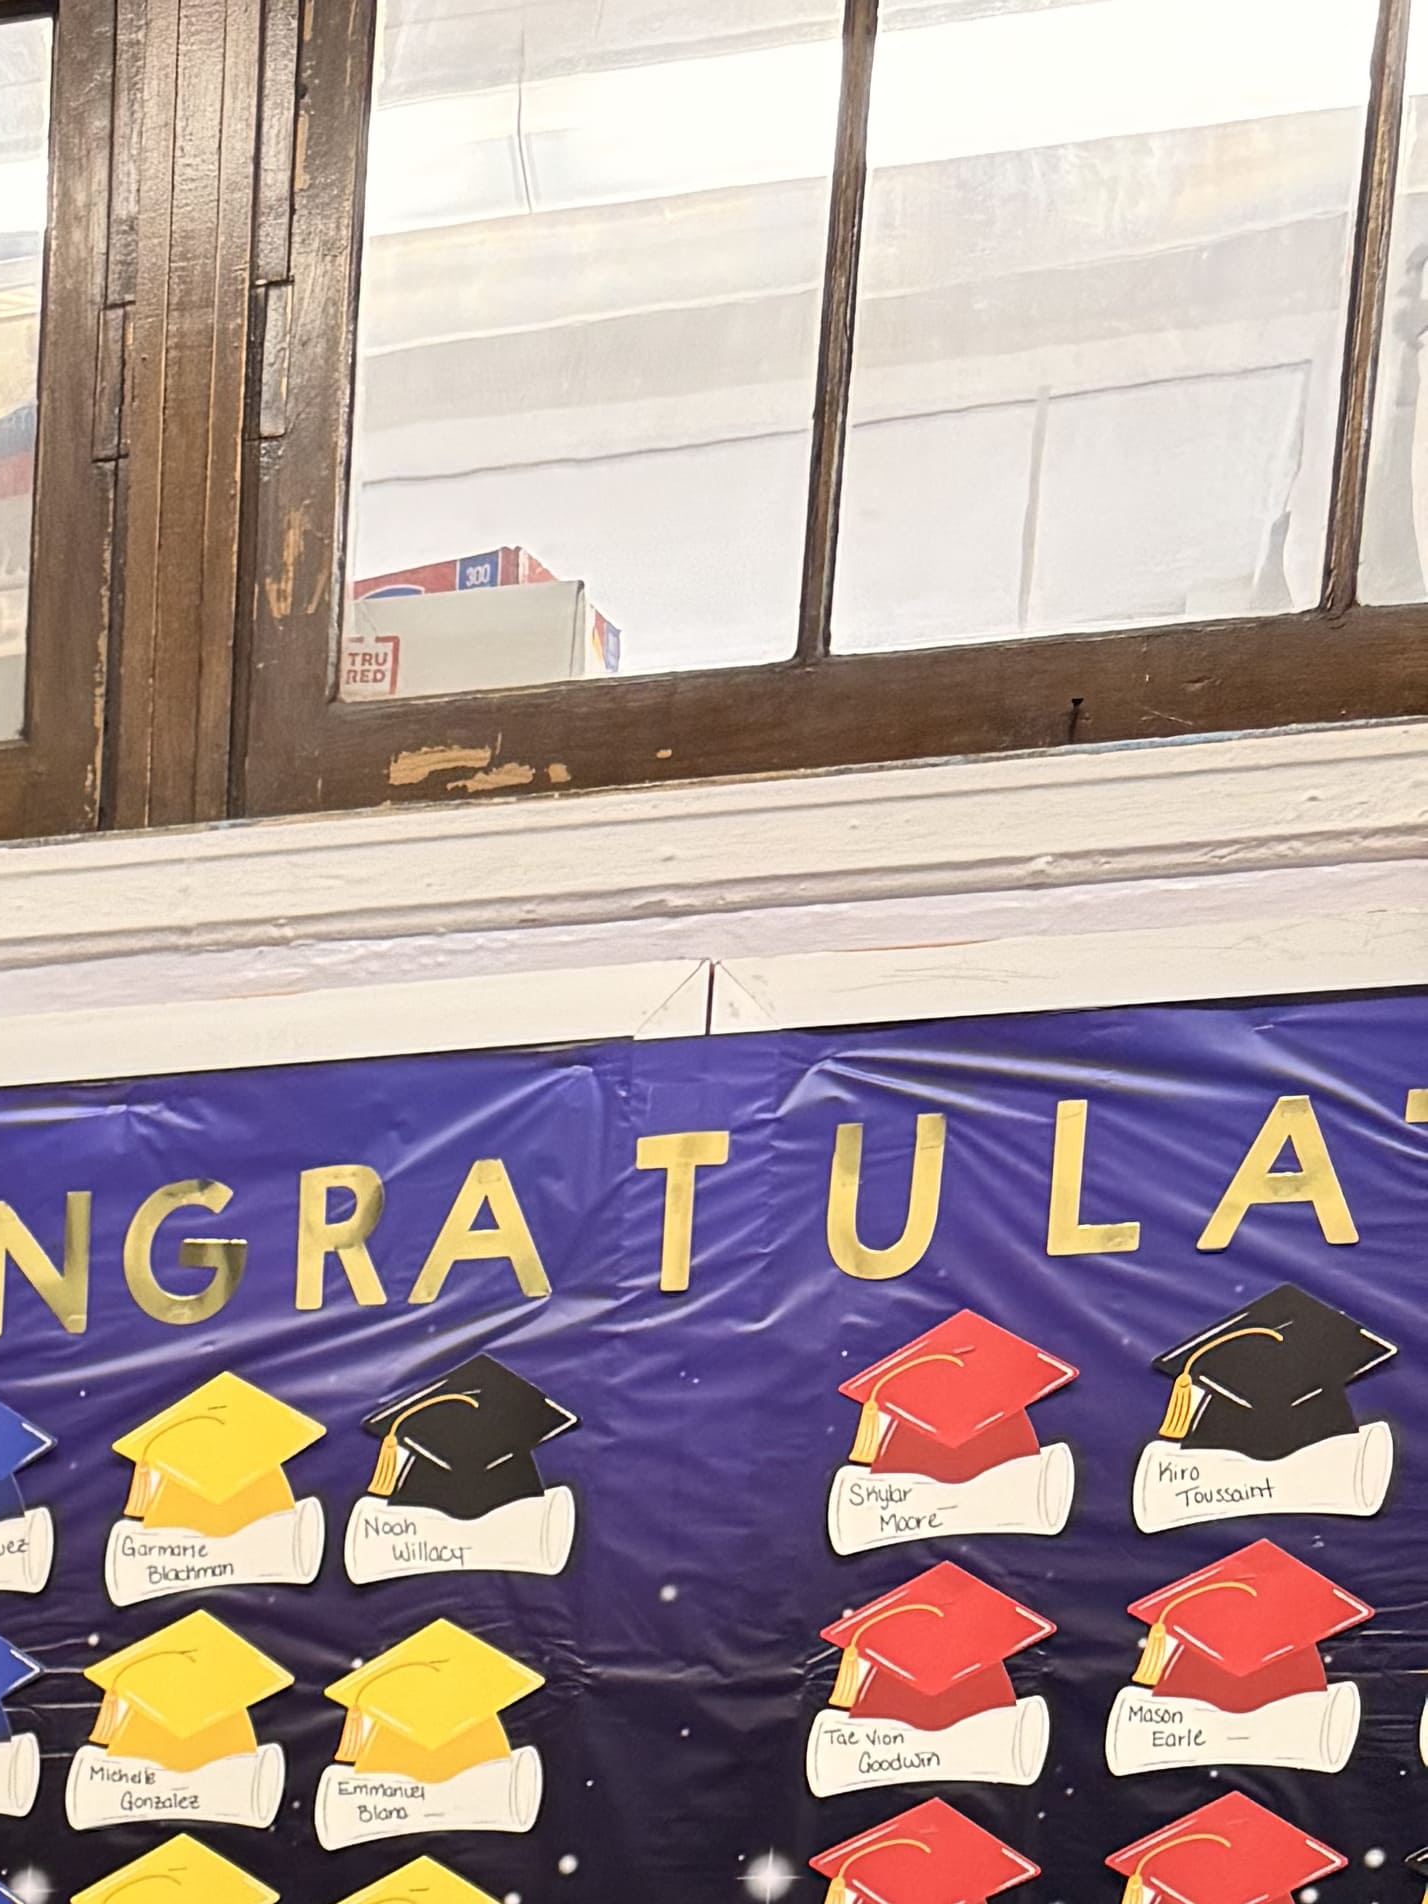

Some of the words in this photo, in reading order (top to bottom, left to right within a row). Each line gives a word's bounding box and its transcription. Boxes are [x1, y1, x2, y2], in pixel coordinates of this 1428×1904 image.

[466, 563, 491, 587] 300
[347, 651, 388, 667] TRU
[346, 669, 387, 685] RED
[1176, 1479, 1276, 1505] Toussaint
[364, 1517, 417, 1538] Noah
[879, 1511, 940, 1533] Moore
[1128, 1703, 1185, 1725] Mason
[824, 1728, 860, 1747] Tae
[1152, 1728, 1207, 1748] Earle
[857, 1750, 941, 1774] Goodwin
[120, 1790, 201, 1811] Gonzalez
[337, 1781, 425, 1800] Emmanuel
